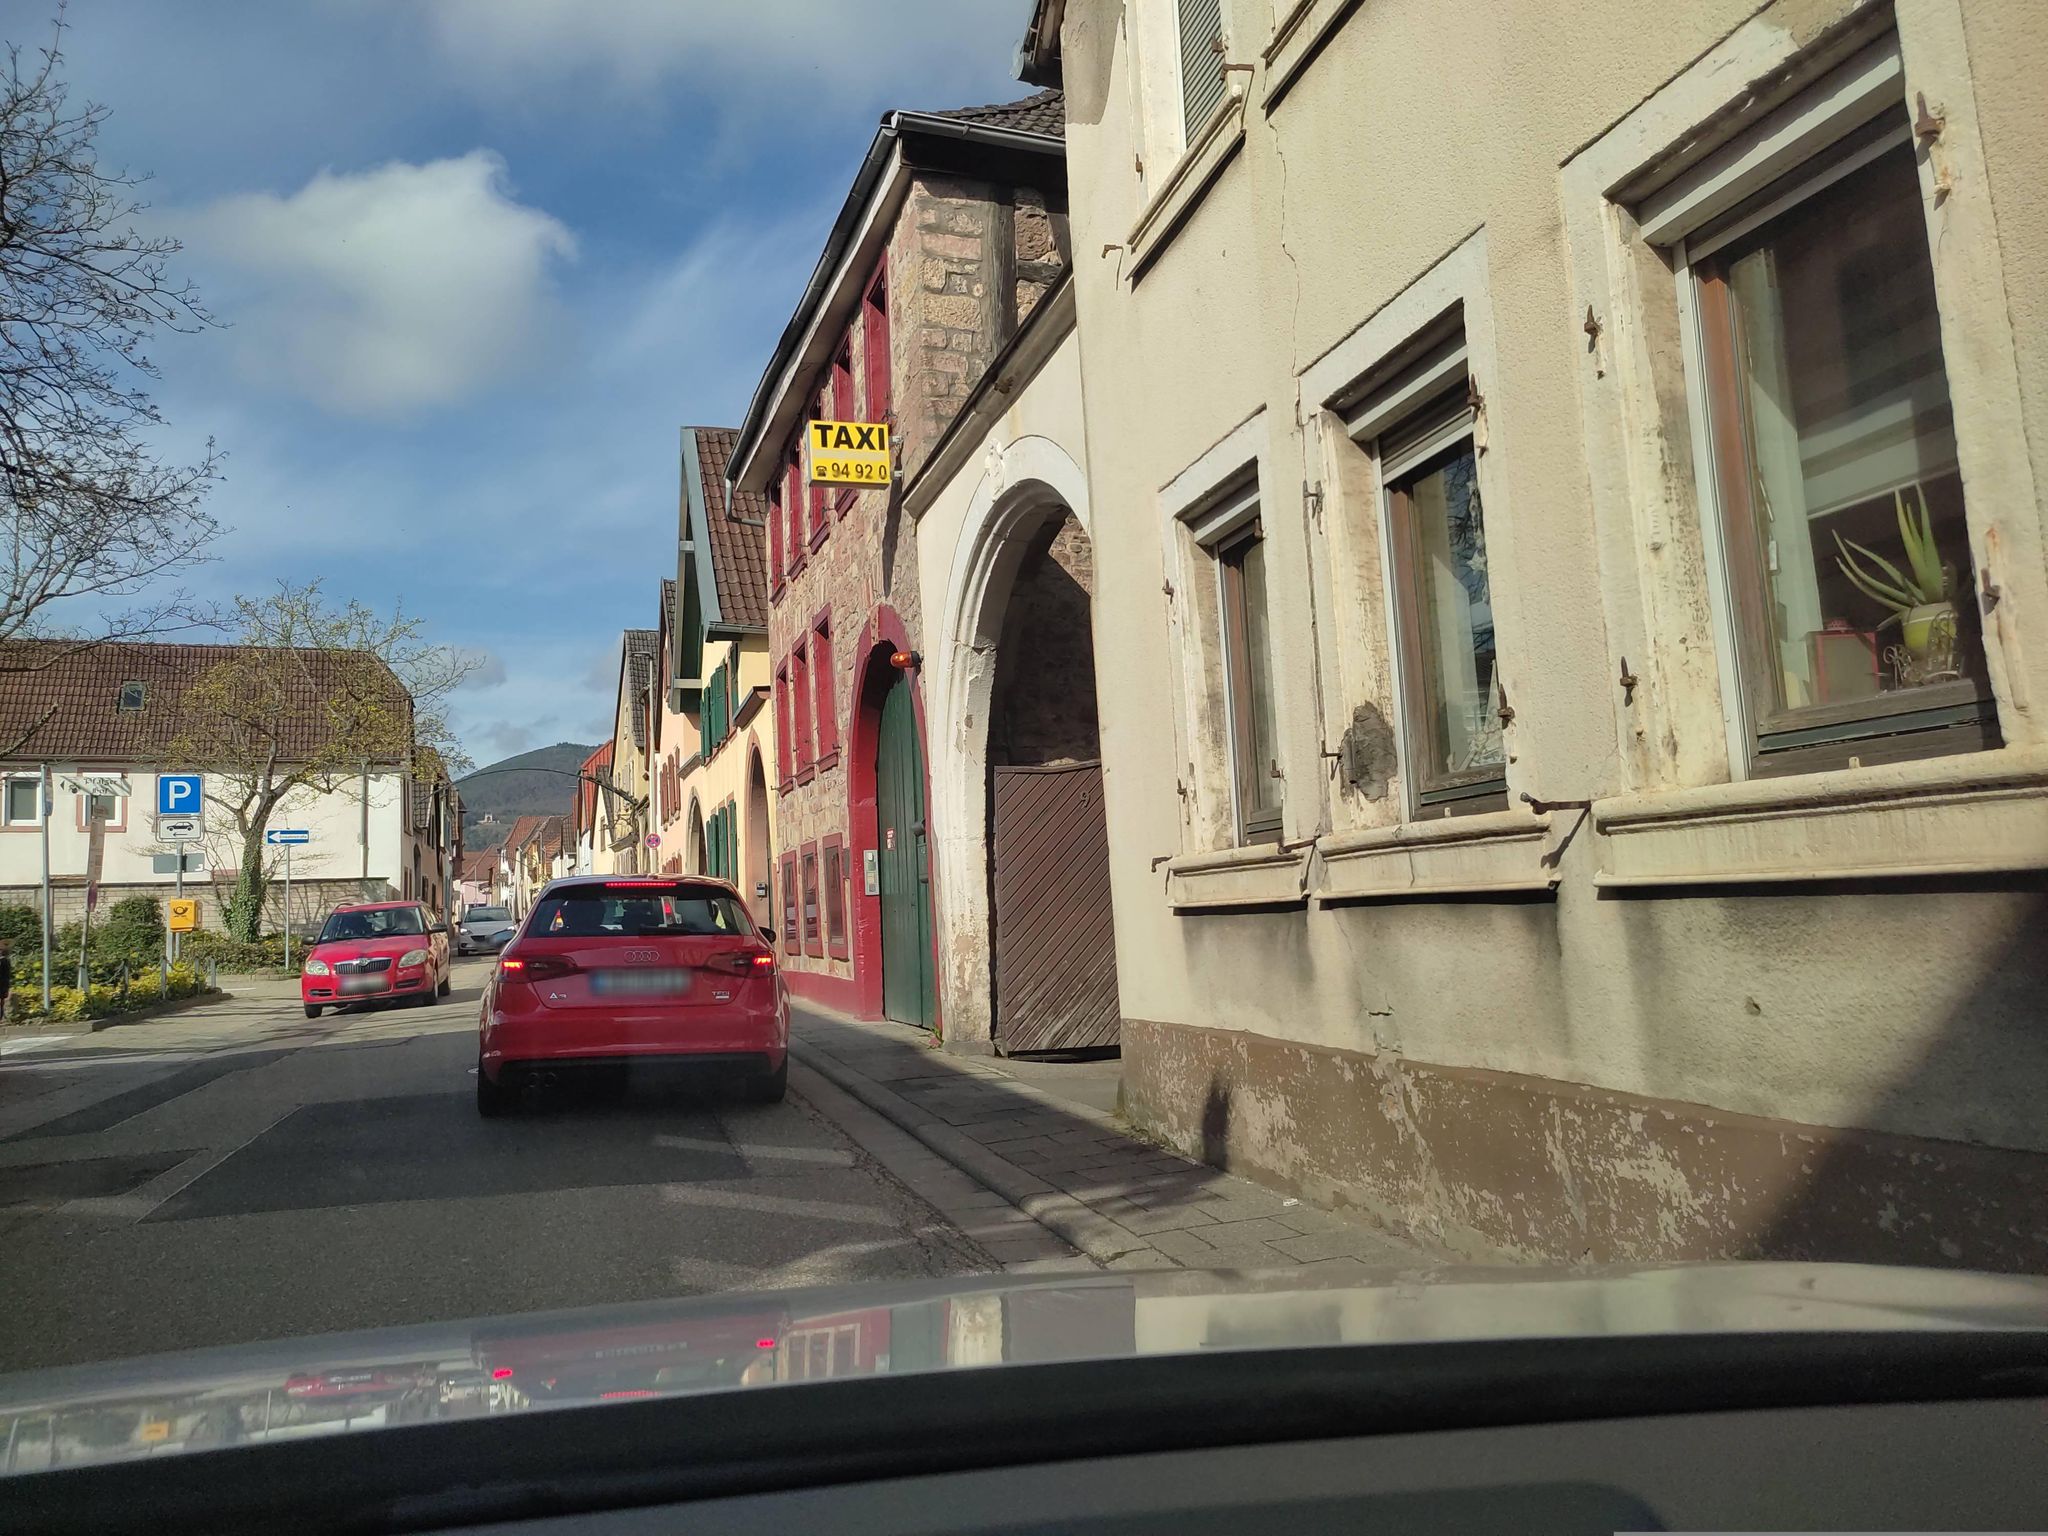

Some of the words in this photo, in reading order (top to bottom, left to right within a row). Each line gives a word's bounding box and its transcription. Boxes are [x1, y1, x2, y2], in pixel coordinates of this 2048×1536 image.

[814, 424, 886, 451] TAXI
[831, 462, 850, 479] 94
[855, 463, 873, 480] 92
[879, 465, 887, 480] 0
[169, 780, 191, 809] P
[1080, 791, 1090, 809] 9
